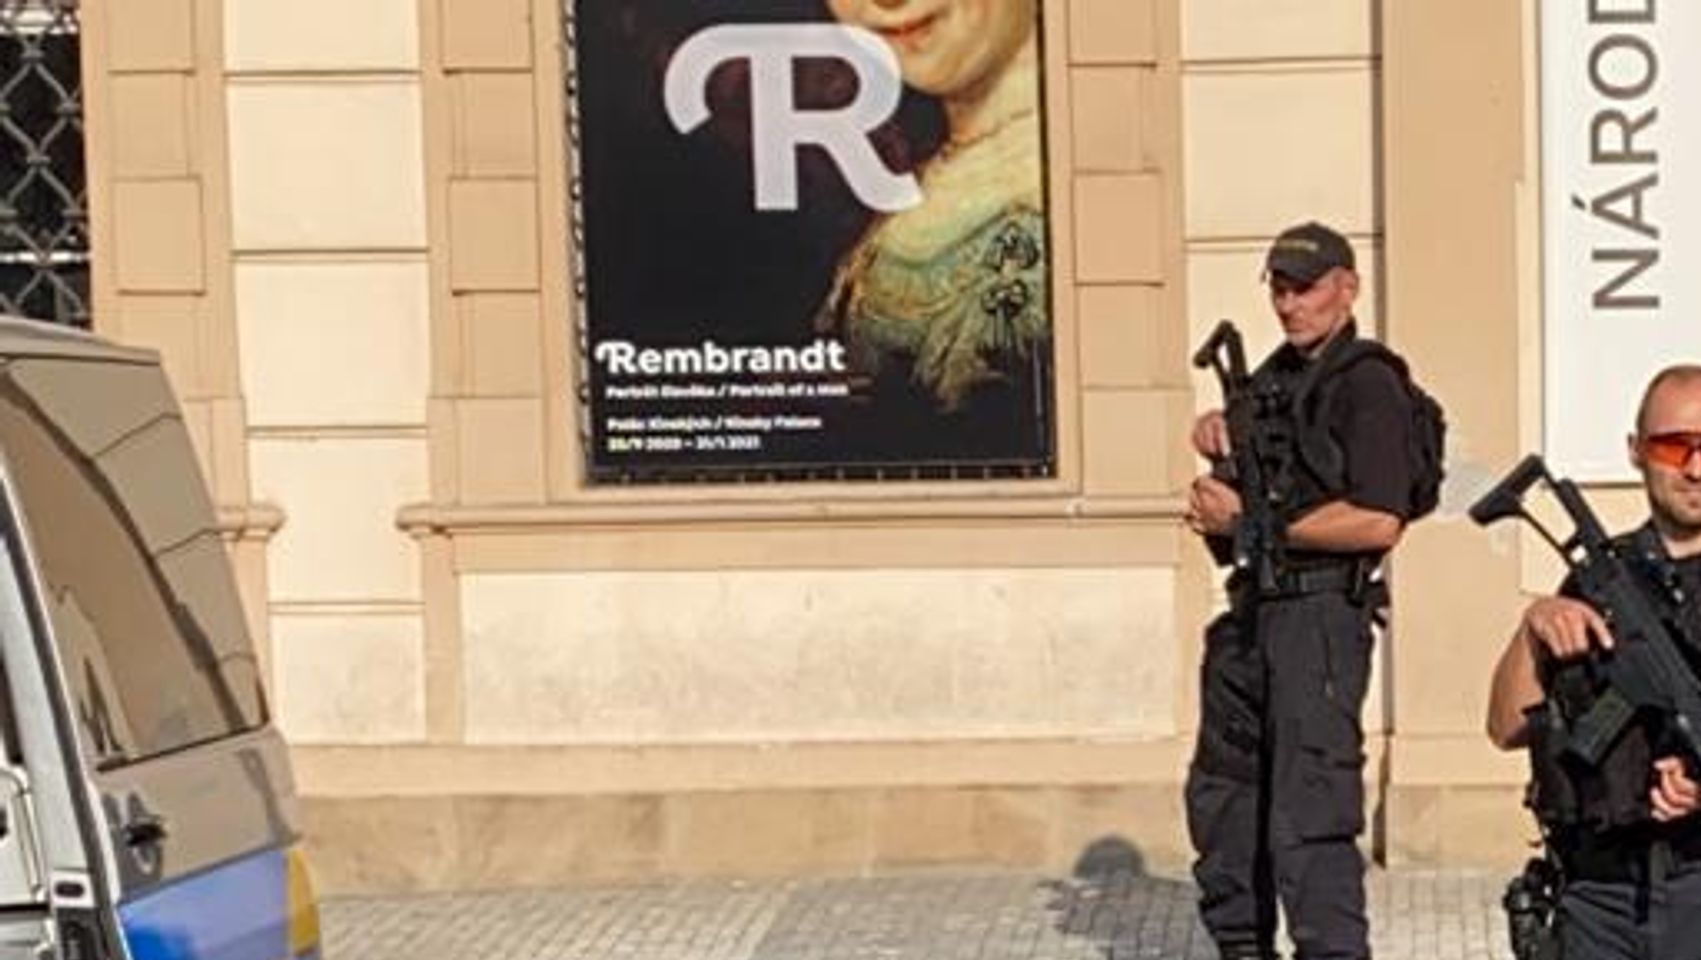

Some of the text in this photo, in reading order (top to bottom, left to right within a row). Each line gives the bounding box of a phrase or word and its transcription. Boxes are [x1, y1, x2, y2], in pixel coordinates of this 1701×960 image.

[664, 22, 923, 211] R
[595, 340, 846, 374] Rembrandt
[787, 382, 805, 398] of
